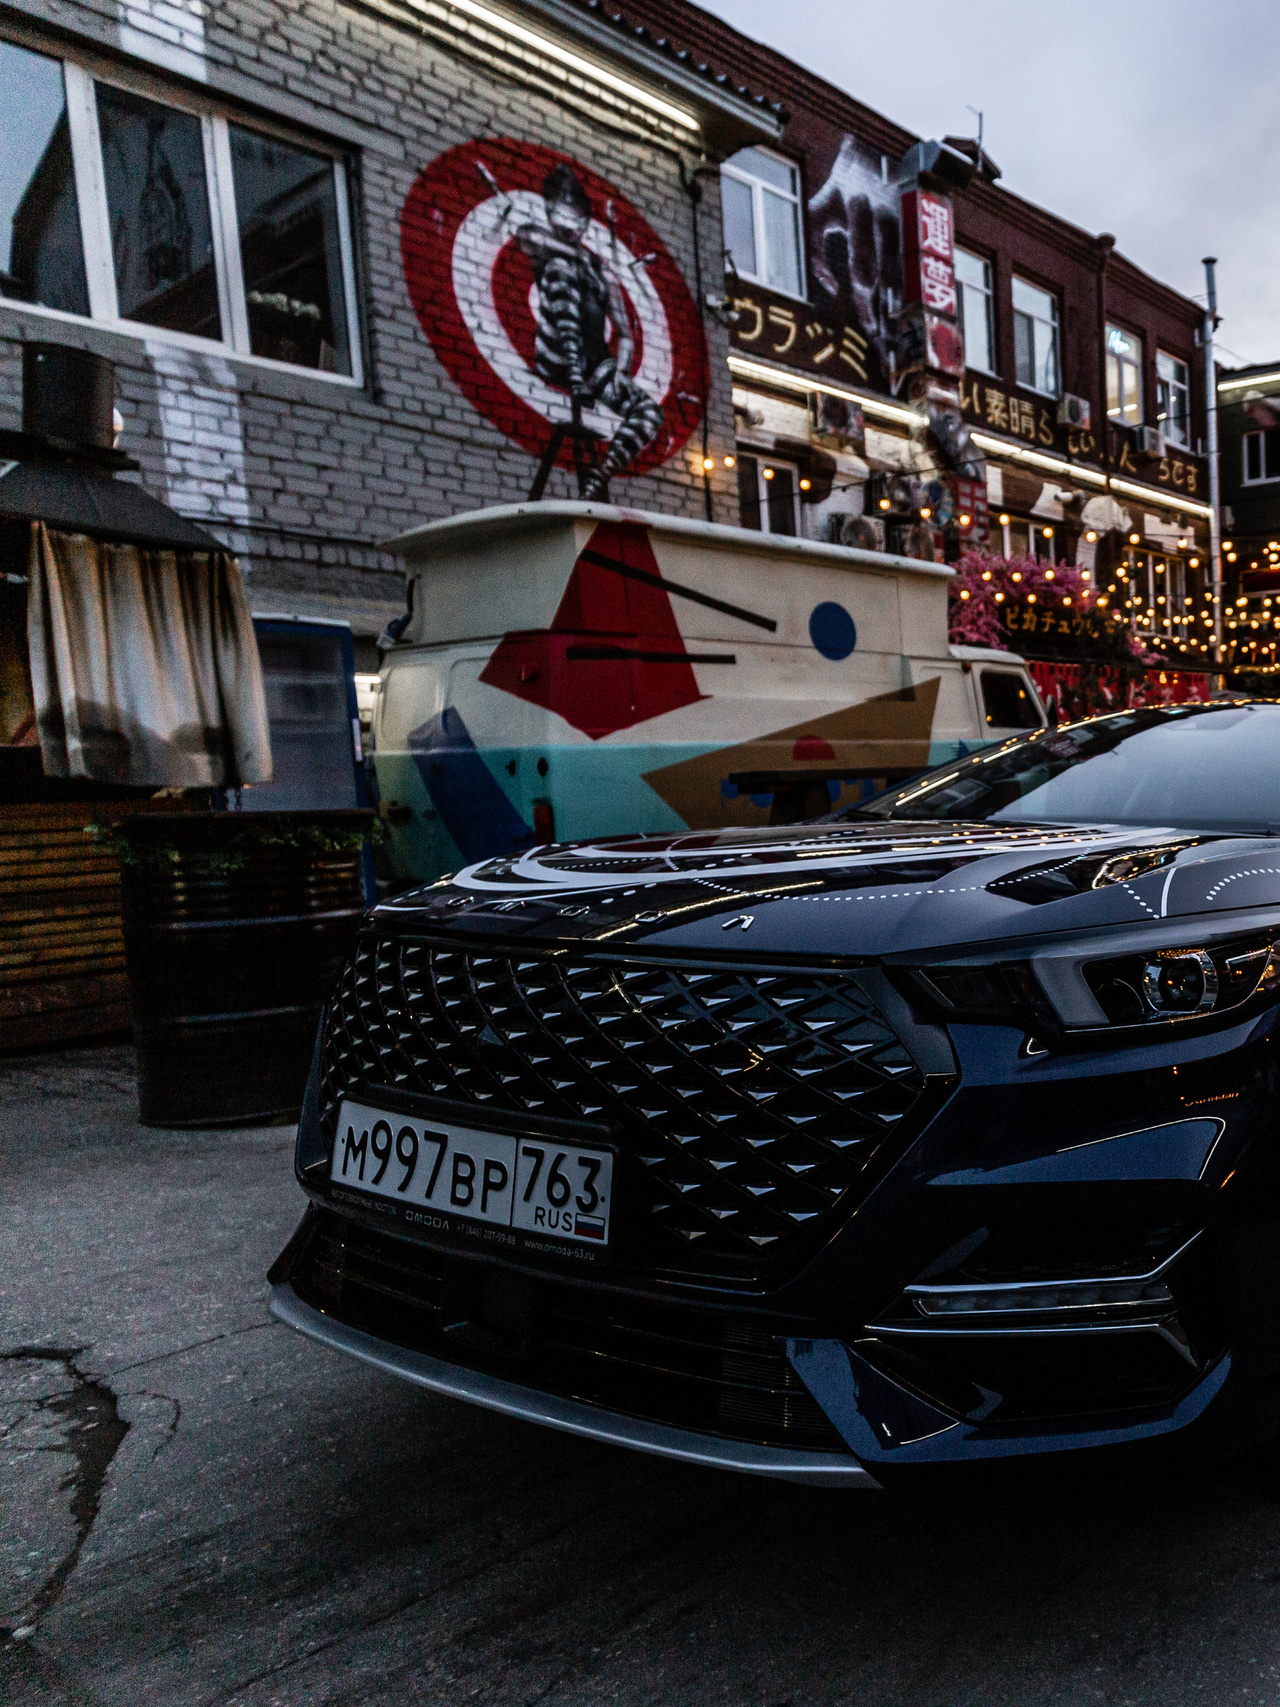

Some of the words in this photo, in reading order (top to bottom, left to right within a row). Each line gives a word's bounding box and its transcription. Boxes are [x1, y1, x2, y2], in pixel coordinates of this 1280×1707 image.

[521, 1146, 602, 1214] 763
[405, 1209, 450, 1231] OMODA
[534, 1206, 573, 1232] RUS
[524, 1239, 595, 1261] www.omoda-63.ru
